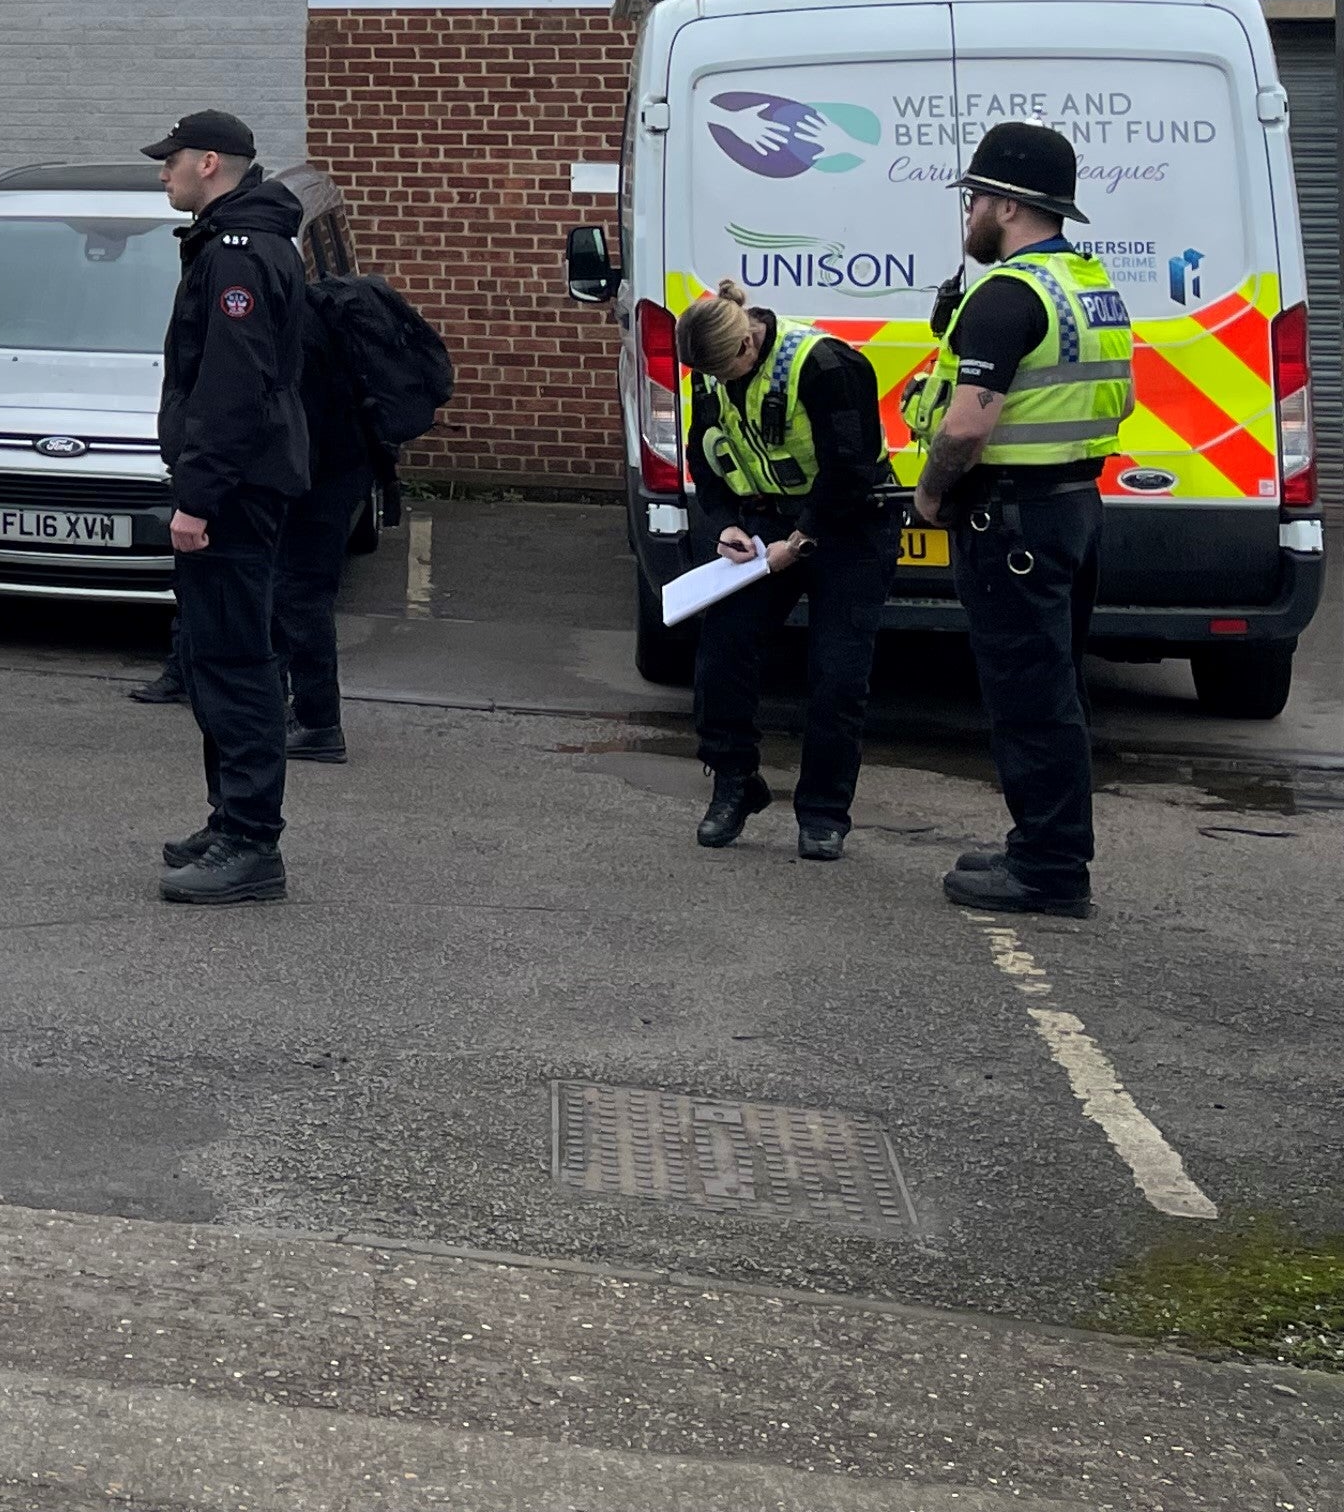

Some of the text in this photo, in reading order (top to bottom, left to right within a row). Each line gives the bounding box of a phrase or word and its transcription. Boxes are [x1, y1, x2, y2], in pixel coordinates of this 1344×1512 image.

[892, 92, 1132, 117] WELFARE AND
[1127, 120, 1217, 144] FUND
[888, 155, 968, 184] Carin
[741, 253, 914, 288] UNISON
[45, 440, 74, 453] Ford
[2, 512, 58, 538] FL16
